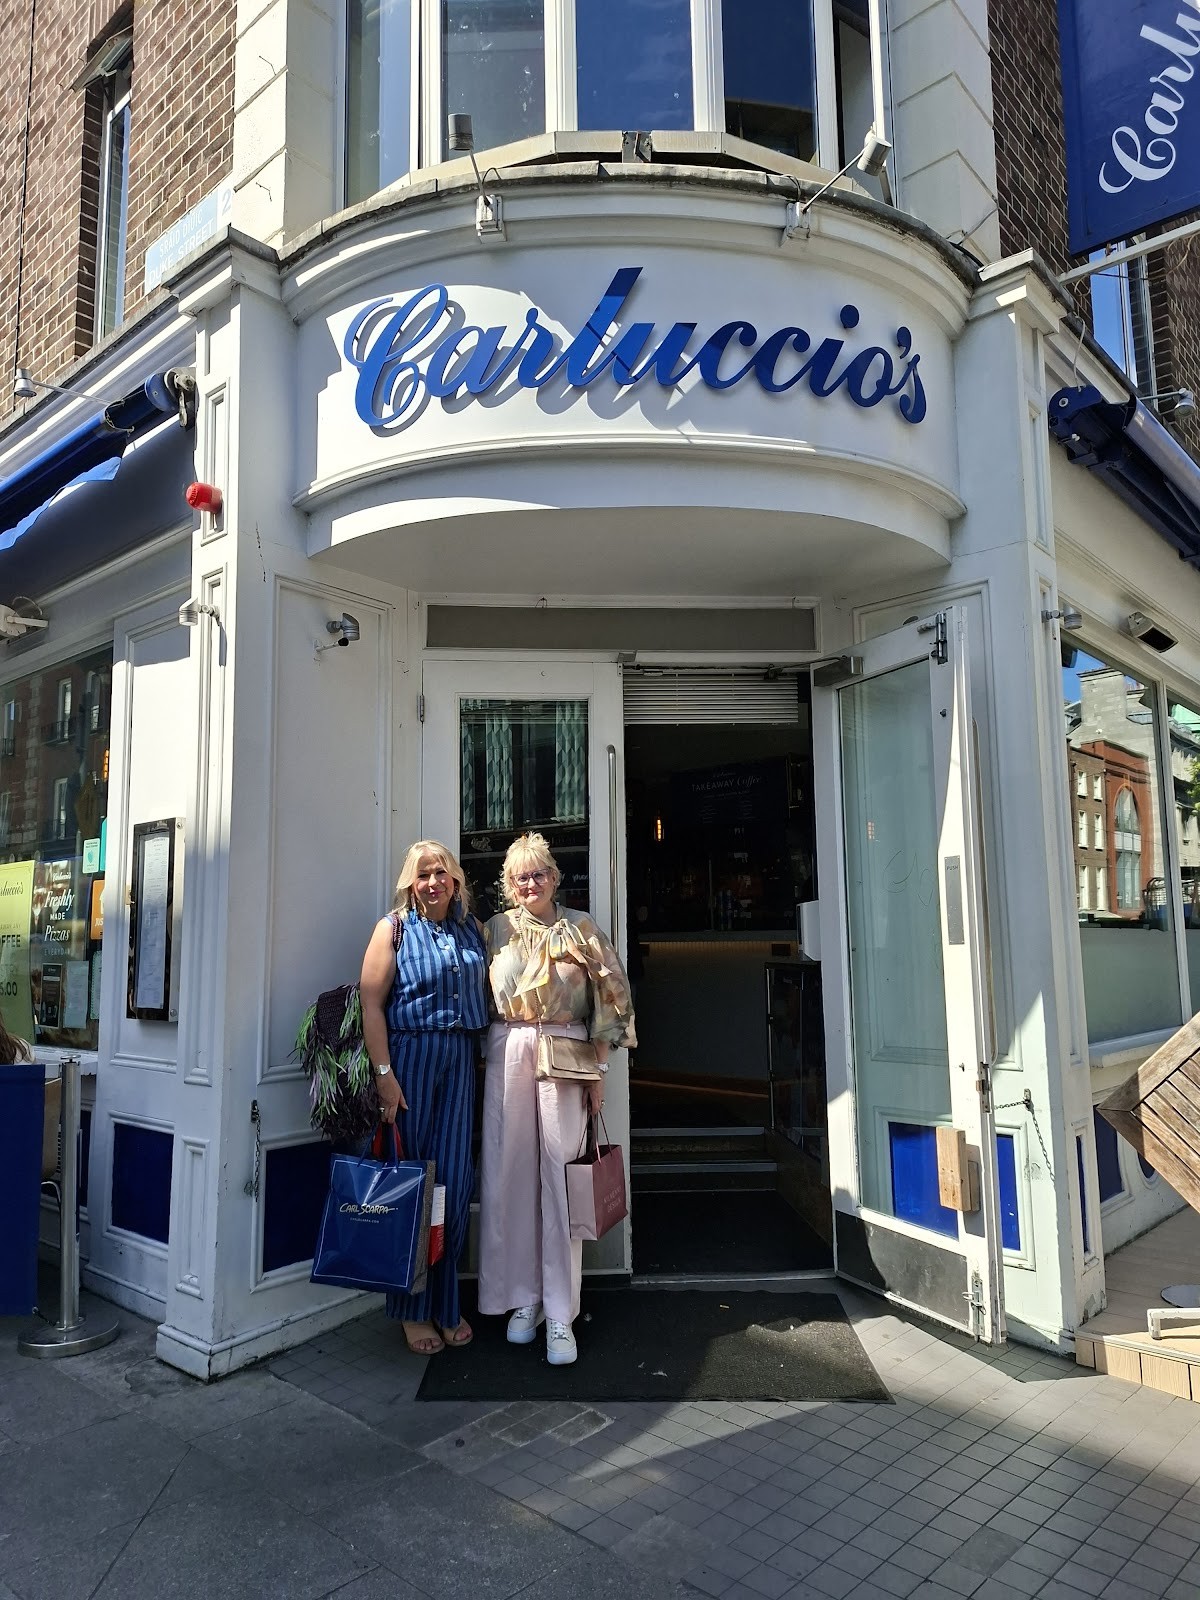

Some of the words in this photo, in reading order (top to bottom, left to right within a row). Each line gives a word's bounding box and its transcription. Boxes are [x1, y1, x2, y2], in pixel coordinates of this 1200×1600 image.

[222, 188, 232, 216] 2
[149, 252, 174, 286] DUKE
[178, 218, 214, 258] STREET
[343, 266, 928, 428] Carluccio's
[691, 779, 735, 792] TAKEAWAY
[44, 888, 76, 911] Freshly
[50, 912, 66, 921] MADE
[0, 934, 21, 948] FFEE
[44, 924, 70, 941] Pizzas
[339, 1202, 360, 1213] CARL
[358, 1203, 396, 1215] SCARPA
